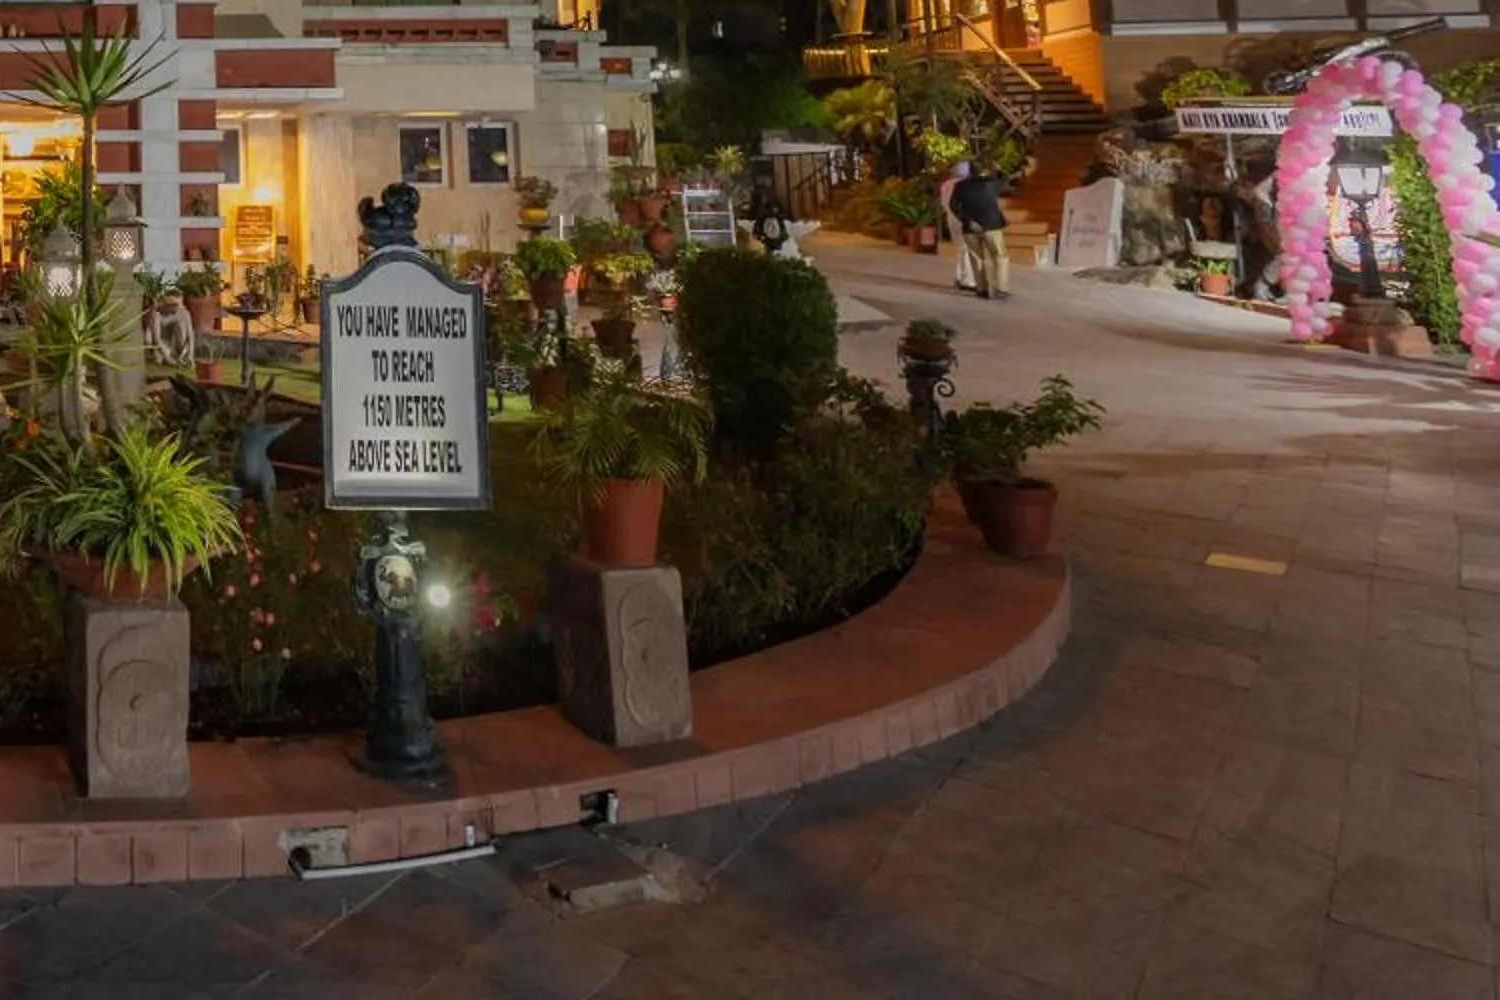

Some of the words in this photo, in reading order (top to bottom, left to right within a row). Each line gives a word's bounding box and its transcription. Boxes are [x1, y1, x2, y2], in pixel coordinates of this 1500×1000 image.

[337, 305, 362, 337] YOU
[366, 305, 399, 338] HAVE
[406, 306, 467, 339] MANAGED
[371, 350, 389, 382] TO
[392, 350, 435, 383] REACH
[363, 394, 392, 428] 1150
[395, 395, 446, 428] METRES
[348, 439, 391, 473] ABOVE
[395, 439, 420, 473] SEA
[423, 441, 463, 474] LEVEL
